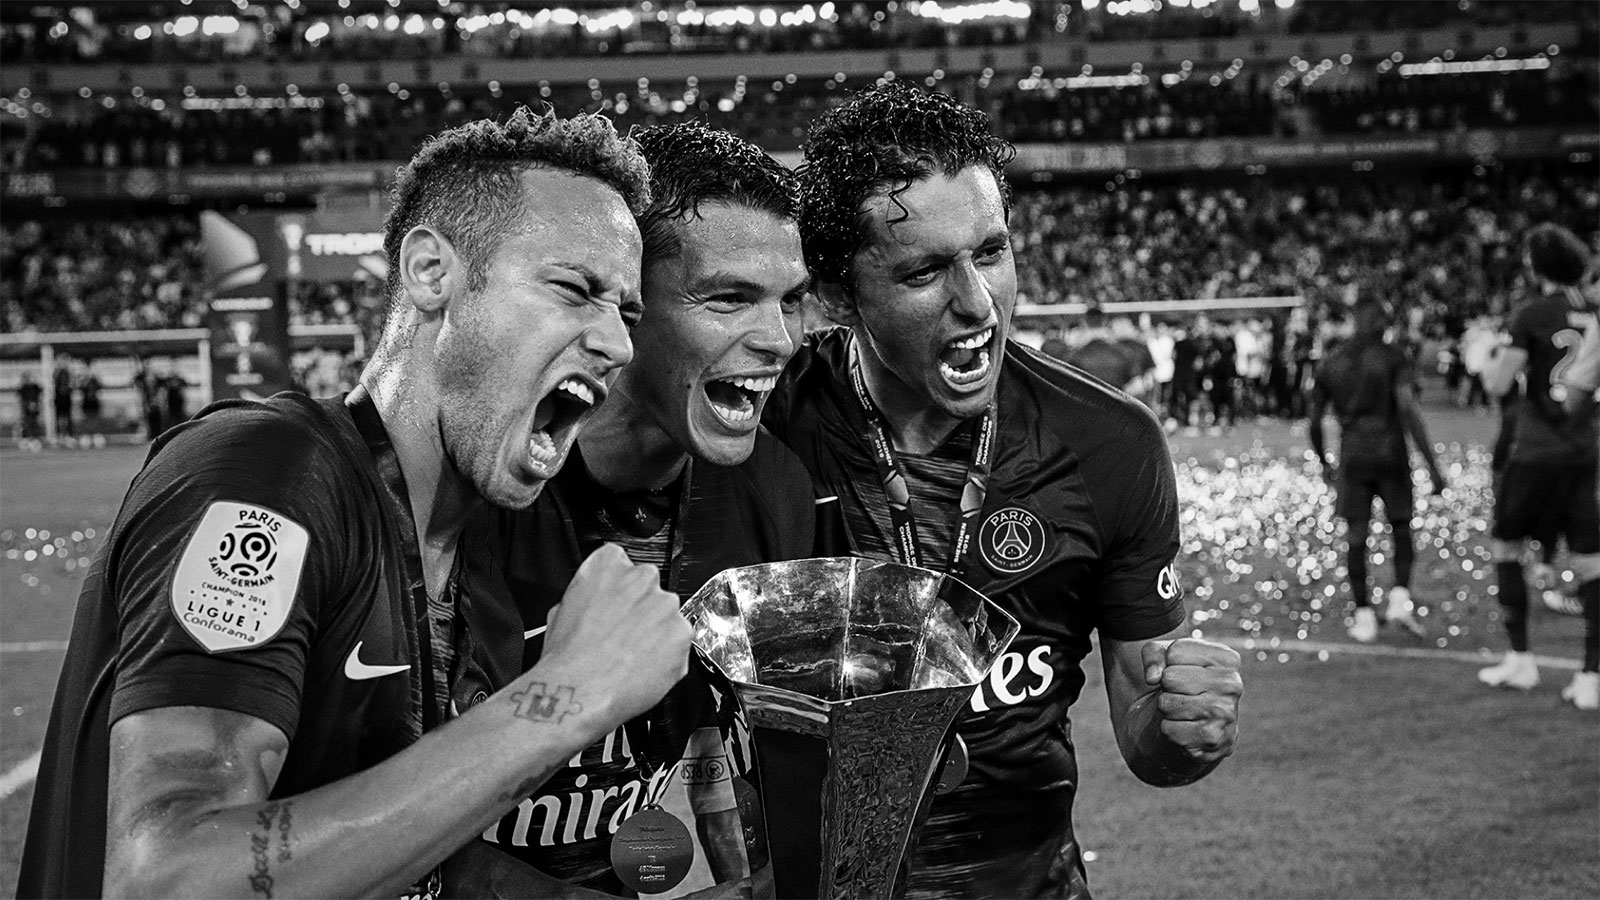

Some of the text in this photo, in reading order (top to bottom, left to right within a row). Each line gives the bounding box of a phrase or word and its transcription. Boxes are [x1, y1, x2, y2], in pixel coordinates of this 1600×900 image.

[305, 233, 385, 255] TROP
[239, 510, 282, 532] PARIS
[990, 511, 1033, 527] PARIS
[899, 526, 911, 566] CHAMPION
[209, 556, 275, 588] SAINT-GERMAIN
[202, 582, 245, 598] CHAMPION
[183, 612, 256, 643] Conforama
[187, 601, 261, 632] LIGUE 1
